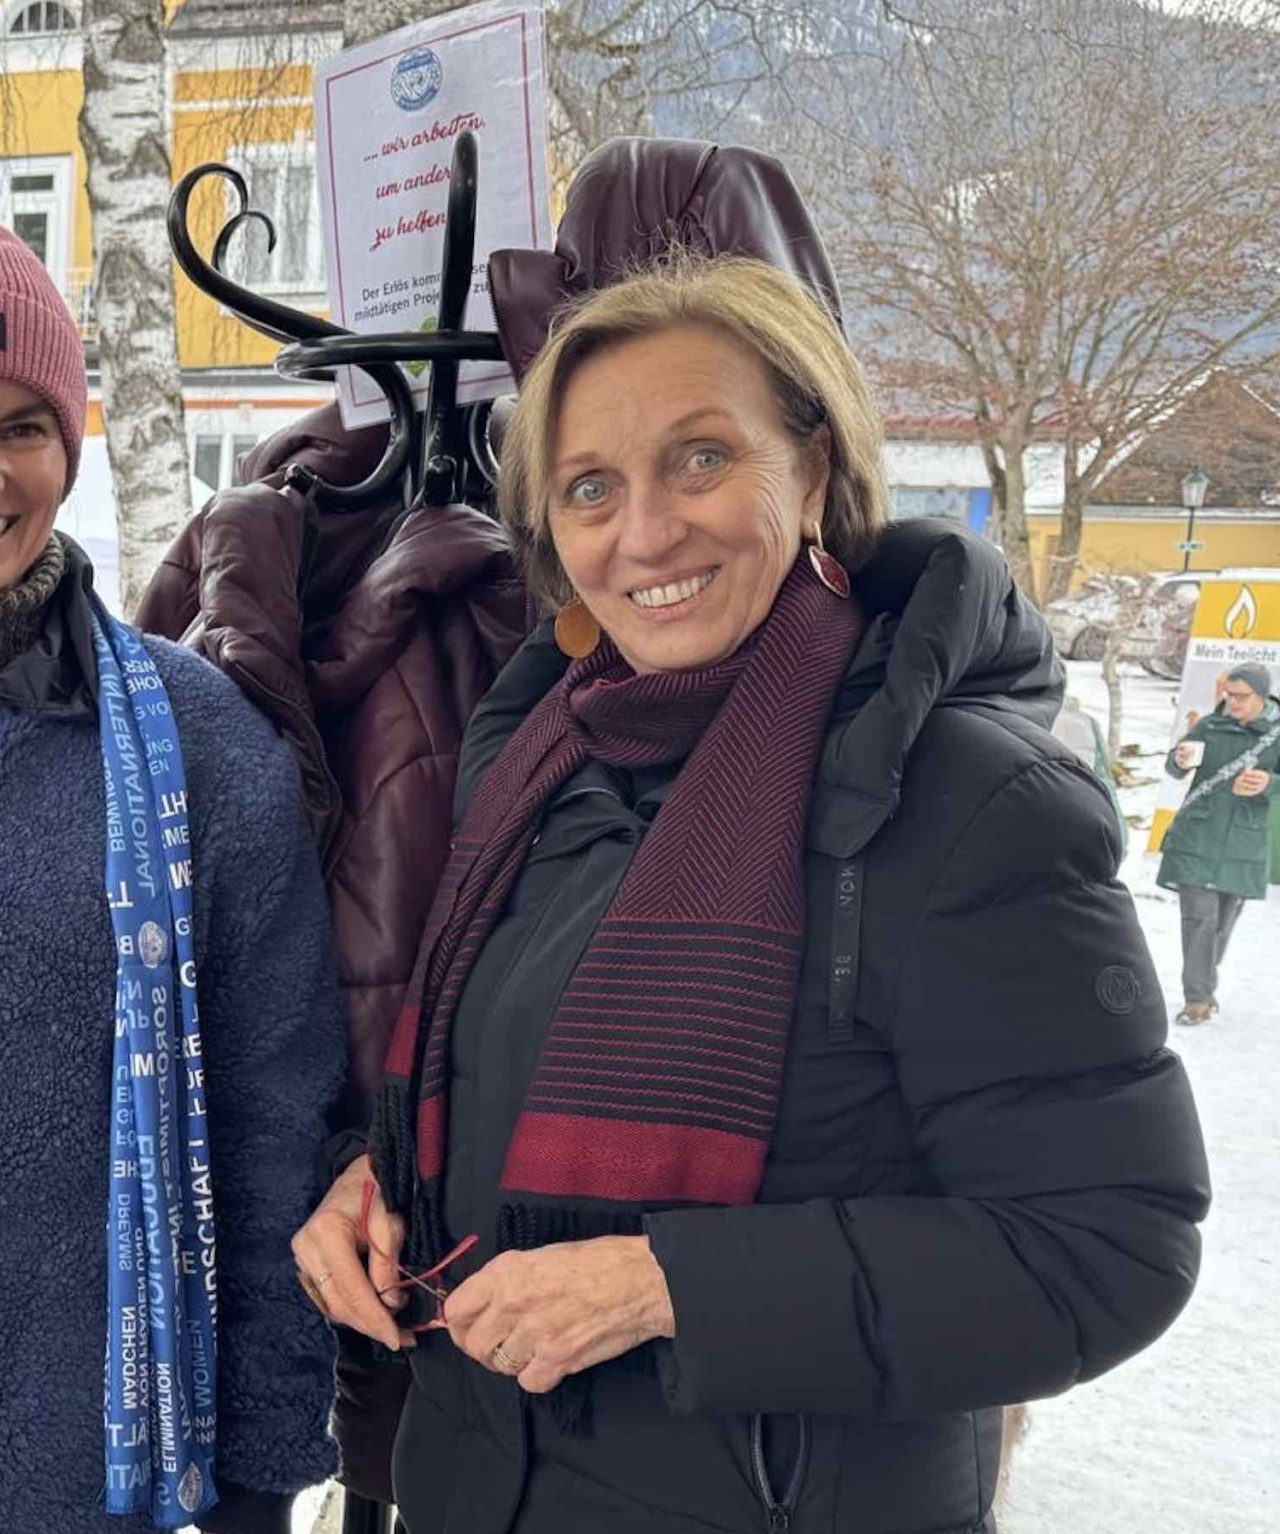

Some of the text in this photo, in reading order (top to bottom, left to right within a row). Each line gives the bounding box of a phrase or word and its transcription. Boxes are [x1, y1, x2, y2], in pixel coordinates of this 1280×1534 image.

[381, 135, 409, 156] wir
[375, 181, 401, 199] um
[369, 227, 394, 252] zu
[361, 288, 380, 301] Der
[382, 279, 410, 296] Erlös
[1195, 642, 1225, 659] Mein
[186, 1318, 211, 1408] WOMEN
